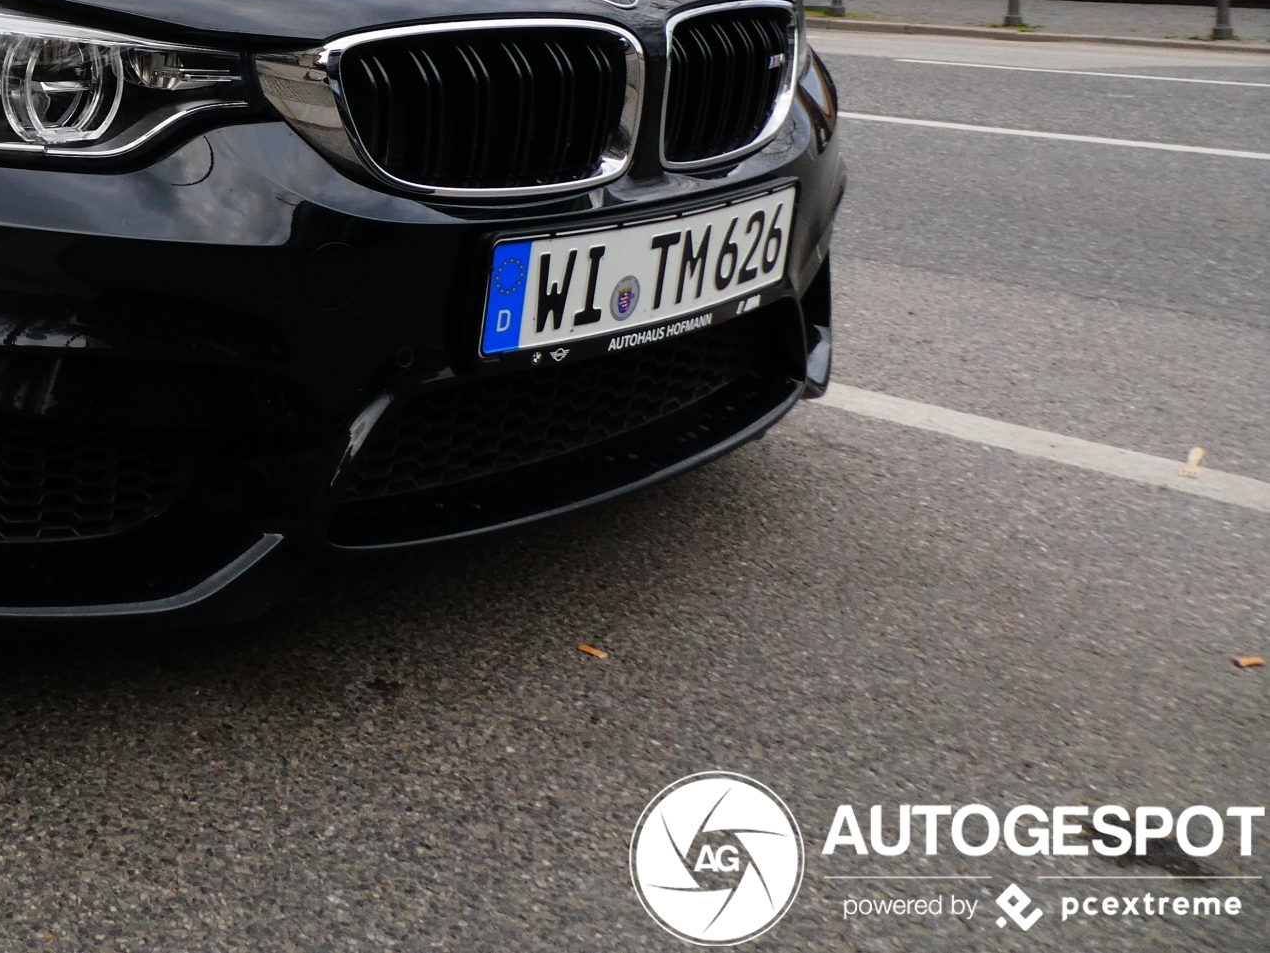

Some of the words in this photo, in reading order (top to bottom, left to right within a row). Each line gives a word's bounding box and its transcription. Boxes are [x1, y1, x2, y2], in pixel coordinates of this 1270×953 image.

[534, 245, 606, 333] WI
[651, 224, 712, 310] TM
[715, 203, 783, 291] 626
[496, 309, 512, 333] D
[607, 326, 665, 352] AUTOHAUS
[666, 312, 713, 338] HOFMANN
